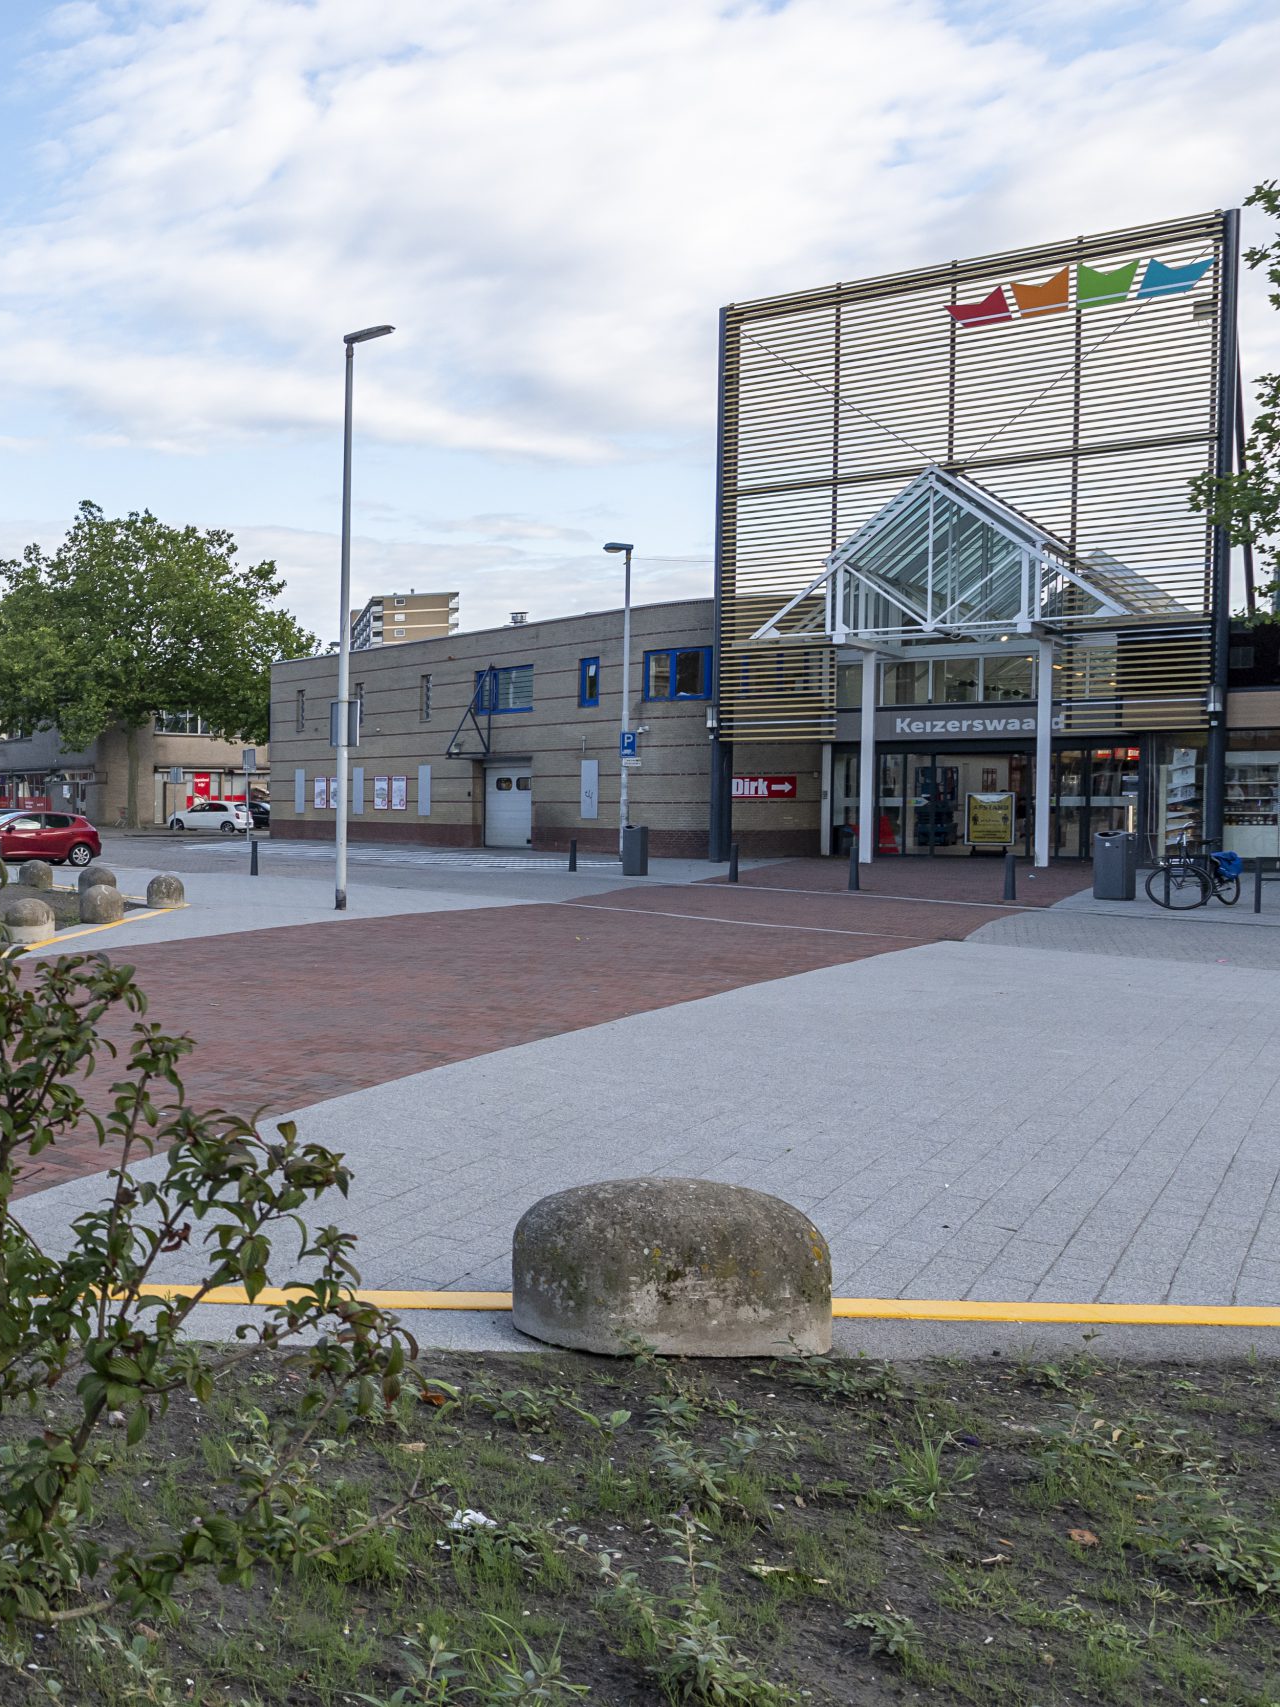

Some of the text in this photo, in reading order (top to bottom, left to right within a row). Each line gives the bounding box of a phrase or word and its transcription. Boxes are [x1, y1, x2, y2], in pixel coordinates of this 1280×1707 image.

[895, 714, 1066, 734] Keizerswaad
[624, 734, 634, 747] P
[731, 778, 769, 796] Dirk
